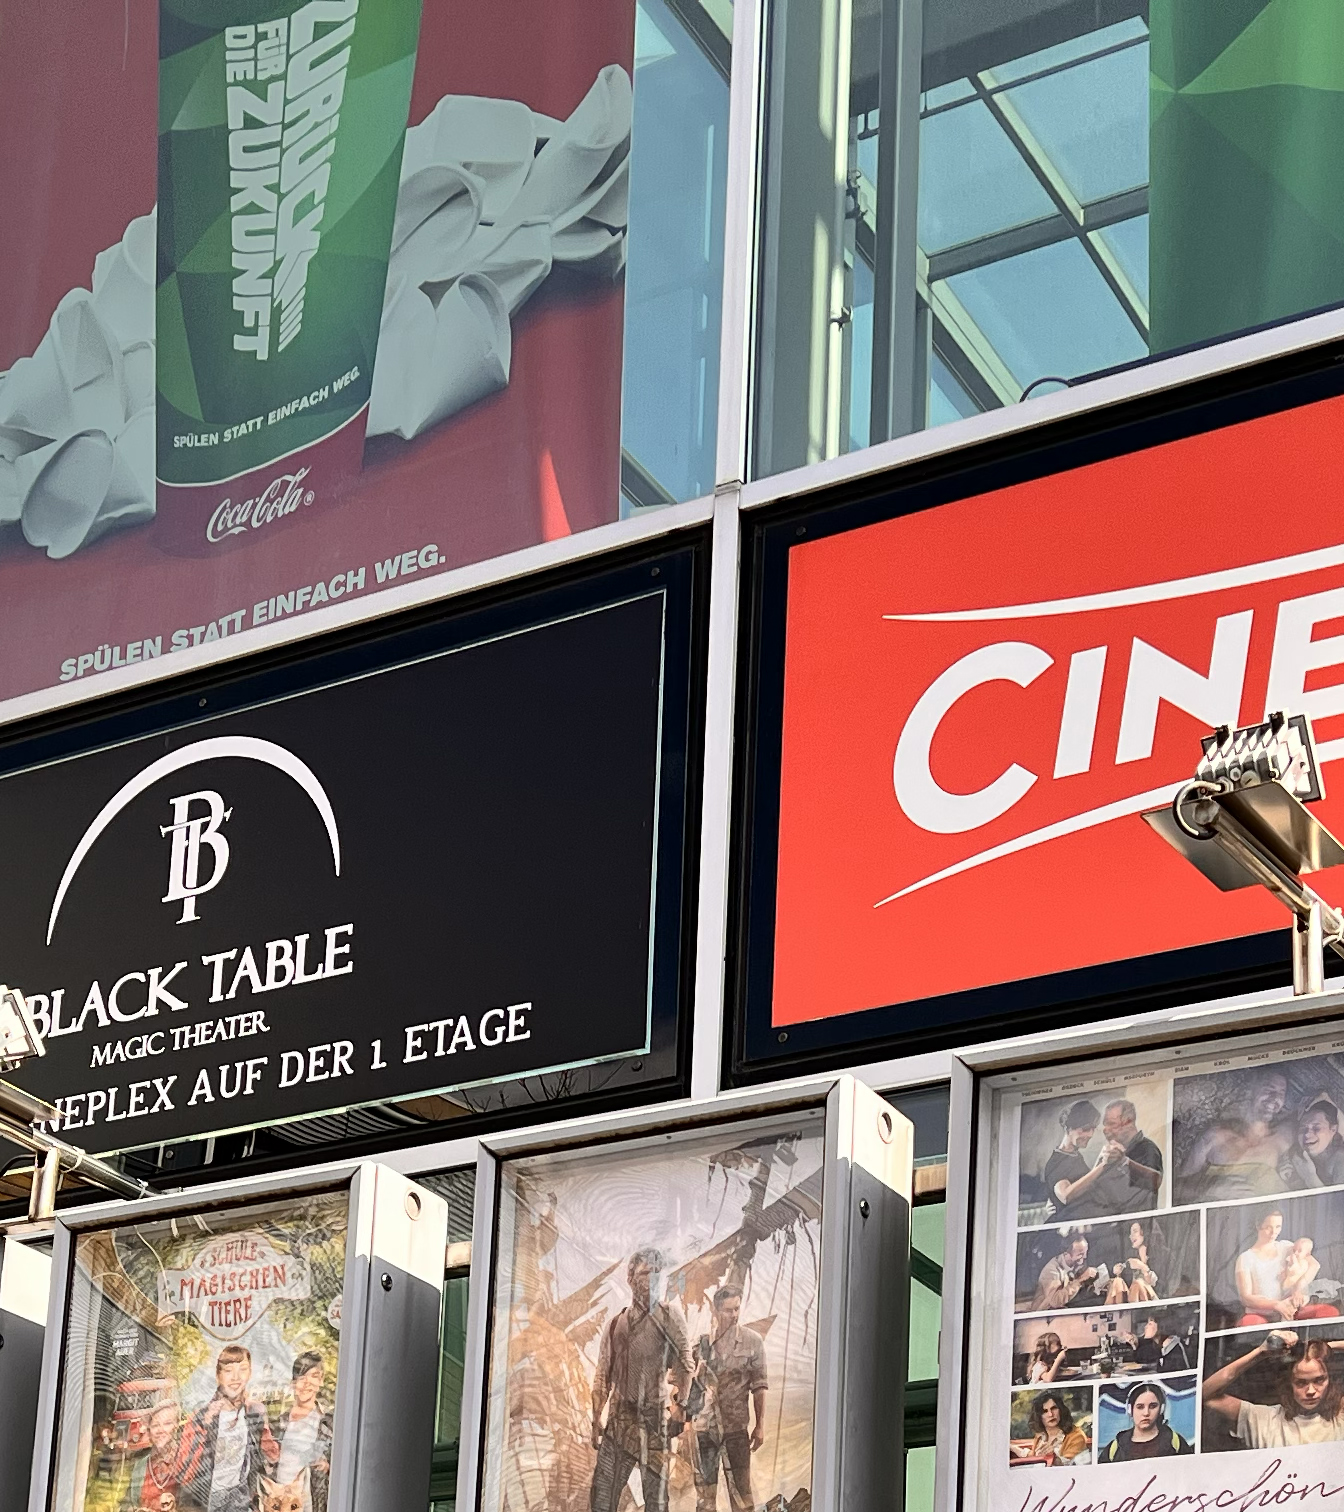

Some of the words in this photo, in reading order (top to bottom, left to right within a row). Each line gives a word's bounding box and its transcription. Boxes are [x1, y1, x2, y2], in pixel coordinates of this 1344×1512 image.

[225, 25, 255, 83] DIE
[227, 81, 284, 360] ZUKUNFT
[173, 431, 219, 448] SPÜLEN
[223, 415, 263, 443] STATT
[267, 391, 329, 426] EINFACH
[331, 366, 360, 395] WEG.
[59, 637, 163, 682] SPÜLEN
[169, 609, 248, 654] STATT
[253, 567, 366, 626] EINFACH
[374, 543, 446, 584] WEG.
[30, 961, 189, 1042] BLACK
[202, 923, 355, 1004] TABLE
[89, 1032, 167, 1069] MAGIC
[188, 1057, 268, 1107] AUF
[279, 1038, 356, 1089] DER
[402, 1003, 533, 1066] ETAGE
[179, 1263, 287, 1301] MAGISCHEN
[209, 1238, 258, 1267] SCHULE
[209, 1295, 253, 1328] TIERE
